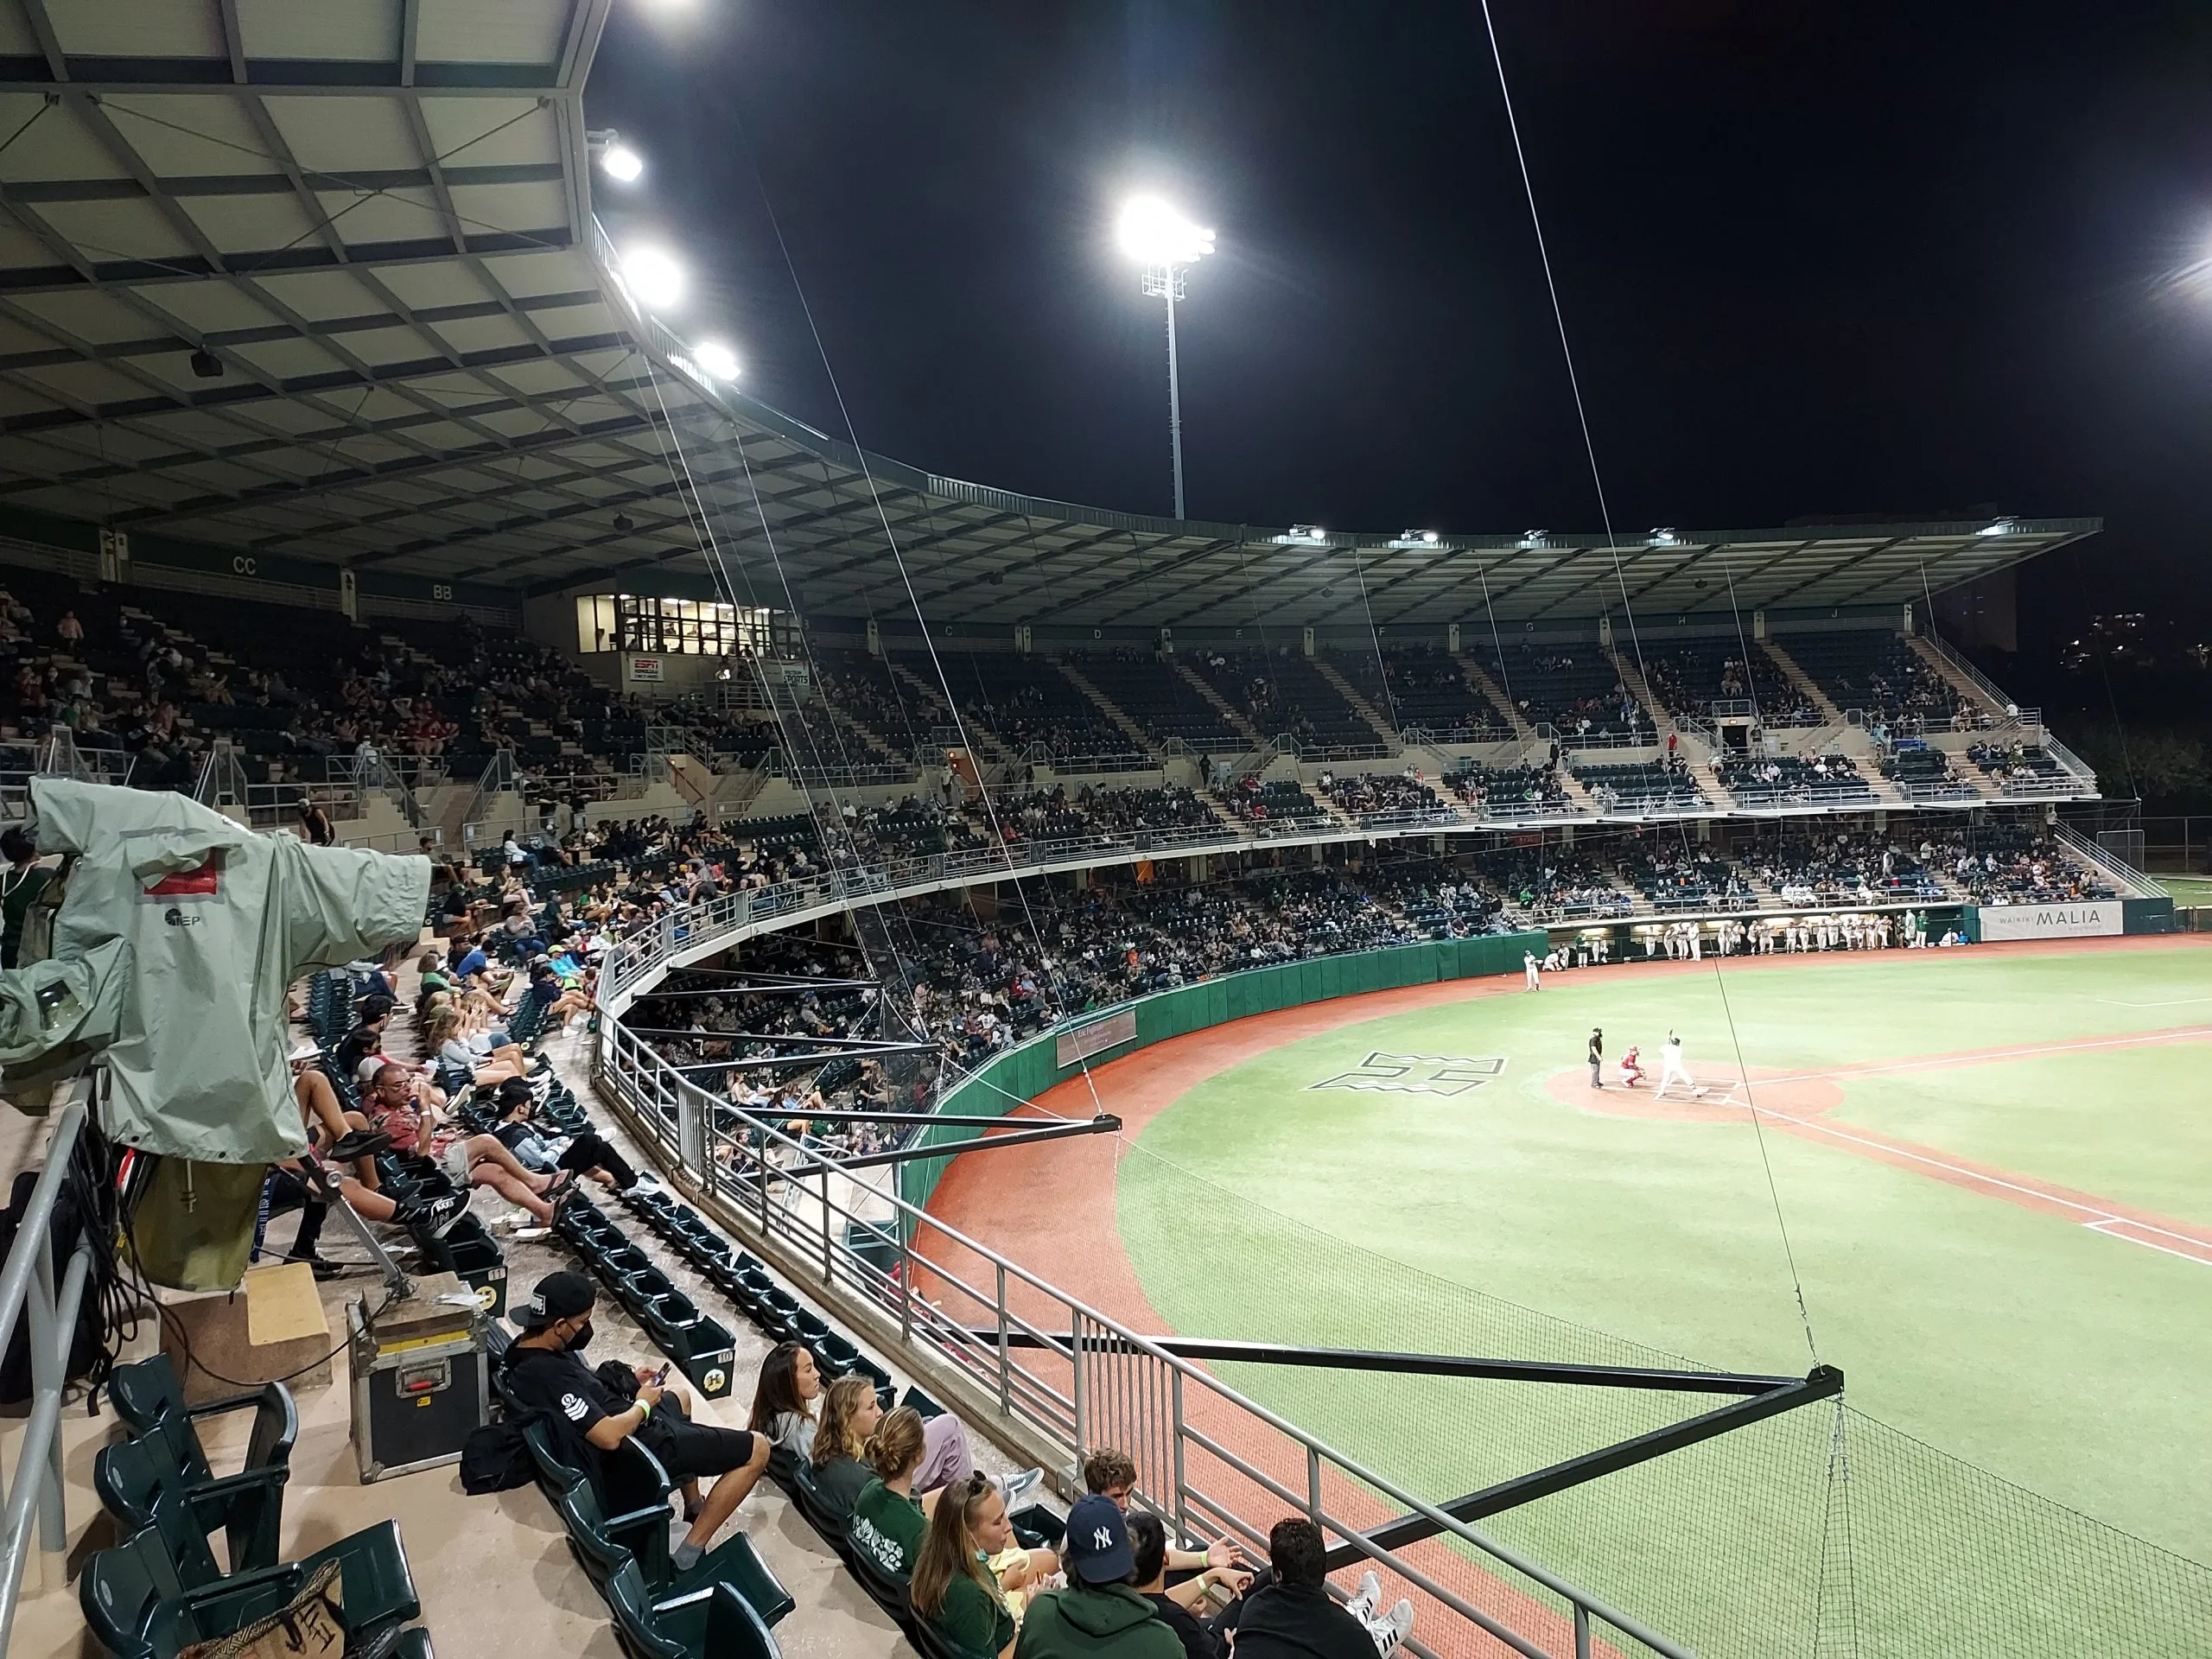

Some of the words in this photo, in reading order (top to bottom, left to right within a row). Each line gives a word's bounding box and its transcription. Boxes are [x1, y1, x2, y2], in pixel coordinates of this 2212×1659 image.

[233, 556, 257, 575] CC
[433, 584, 453, 601] BB
[1831, 608, 1838, 619] J
[1678, 616, 1687, 626] H
[945, 626, 953, 636] C
[1378, 626, 1386, 637] F
[1526, 622, 1535, 632] G
[1094, 629, 1102, 639] D
[1236, 629, 1243, 639] E
[783, 675, 809, 683] SPORTS
[2036, 910, 2101, 925] MALIA
[491, 1269, 502, 1280] 11
[720, 1351, 731, 1363] 10
[1093, 1525, 1113, 1551] NY
